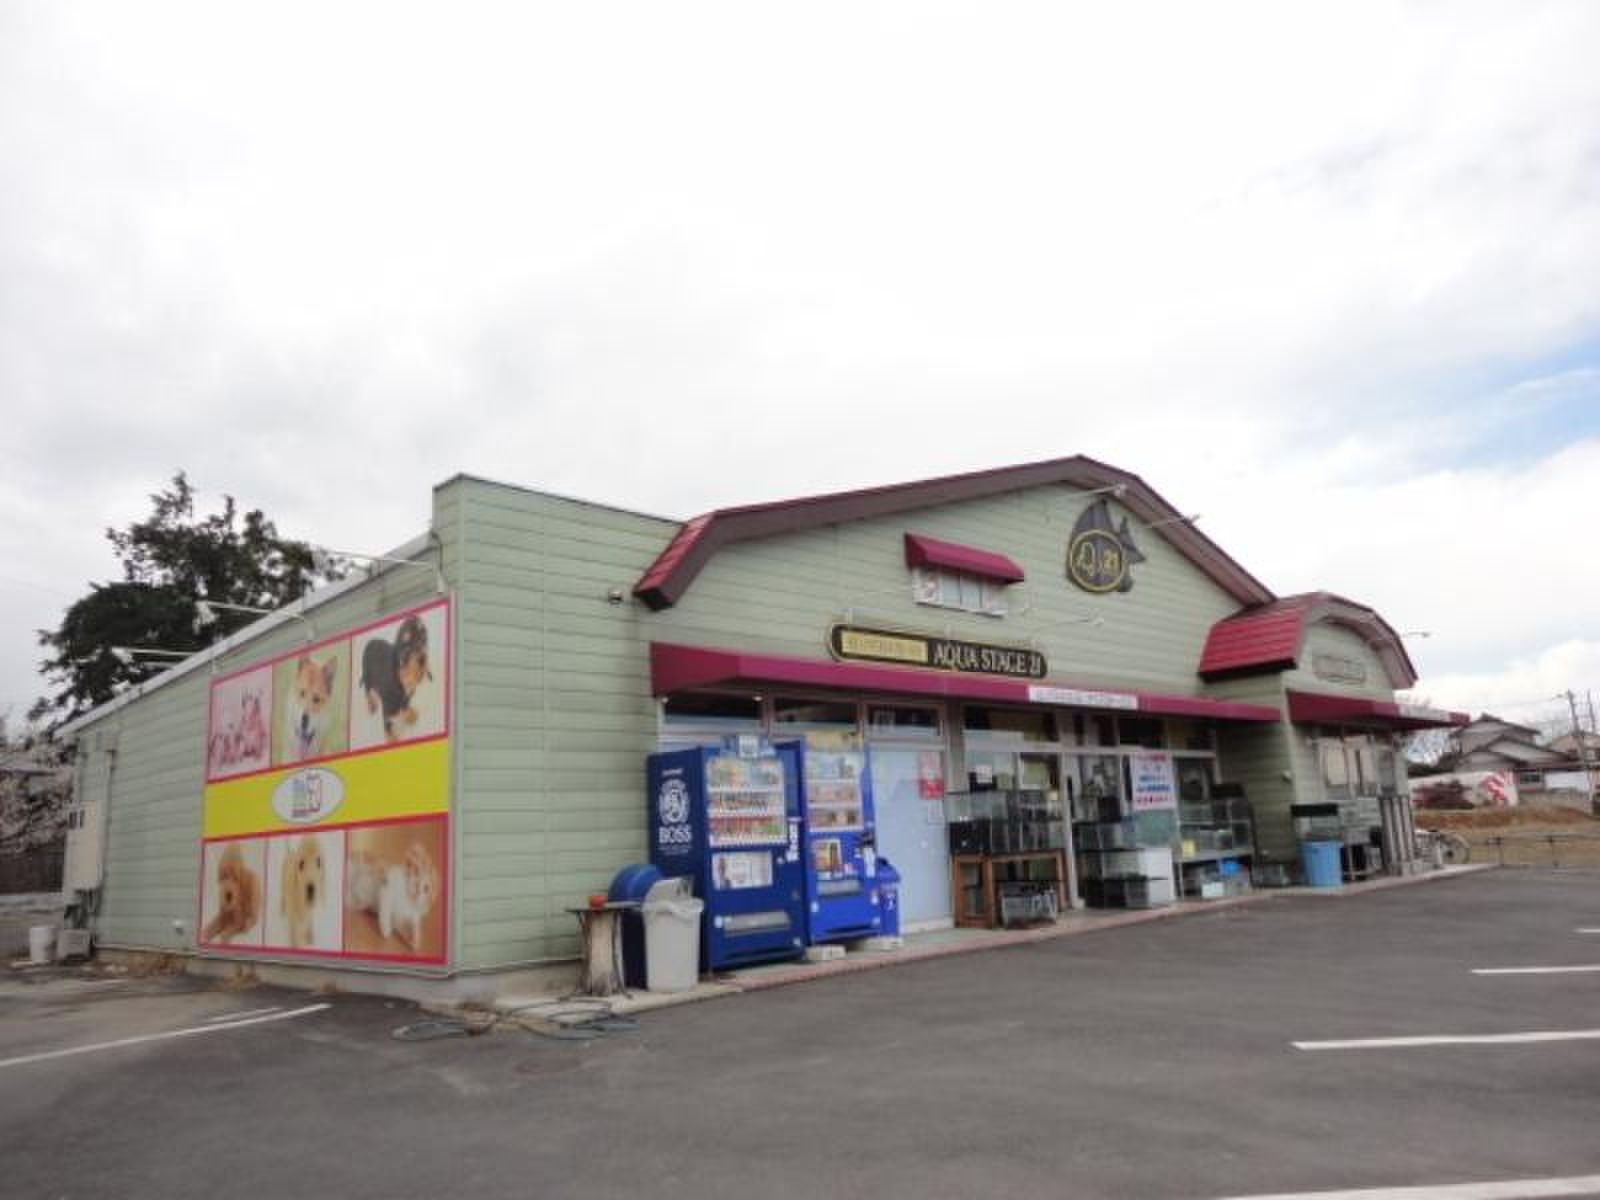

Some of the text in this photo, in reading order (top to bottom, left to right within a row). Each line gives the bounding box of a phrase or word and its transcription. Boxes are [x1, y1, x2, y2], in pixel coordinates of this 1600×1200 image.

[933, 641, 978, 671] AQUA
[980, 646, 1025, 673] STAGE
[659, 825, 692, 844] BOSS
